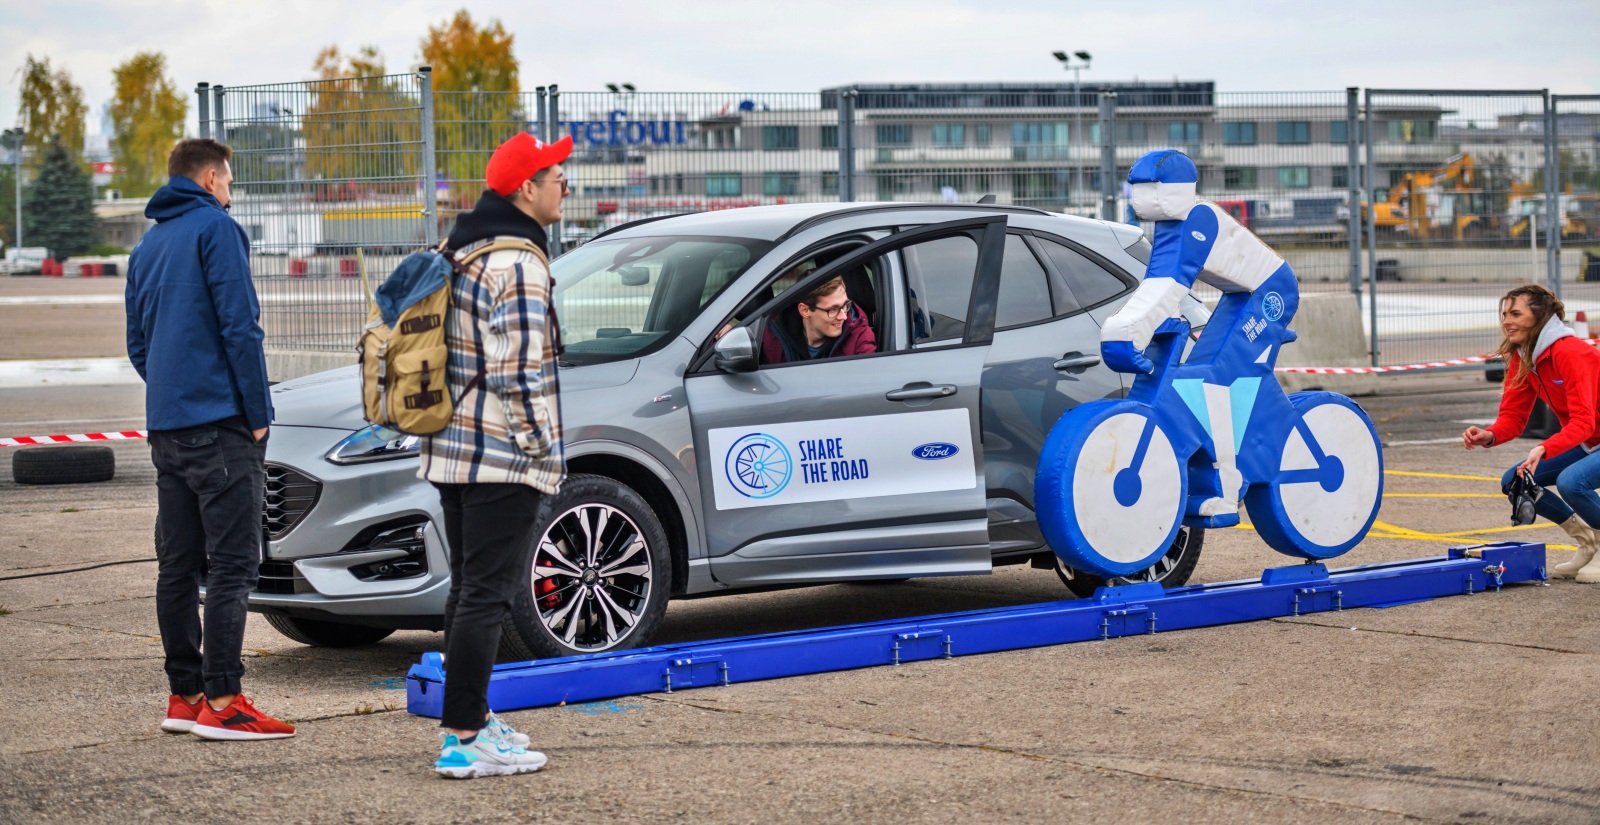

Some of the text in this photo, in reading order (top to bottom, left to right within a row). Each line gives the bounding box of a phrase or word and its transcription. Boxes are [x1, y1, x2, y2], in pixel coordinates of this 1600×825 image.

[530, 110, 687, 145] refour
[1242, 316, 1257, 335] SHARE
[1247, 318, 1268, 343] THE ROAD
[799, 437, 844, 462] SHARE
[800, 459, 869, 484] THE ROAD
